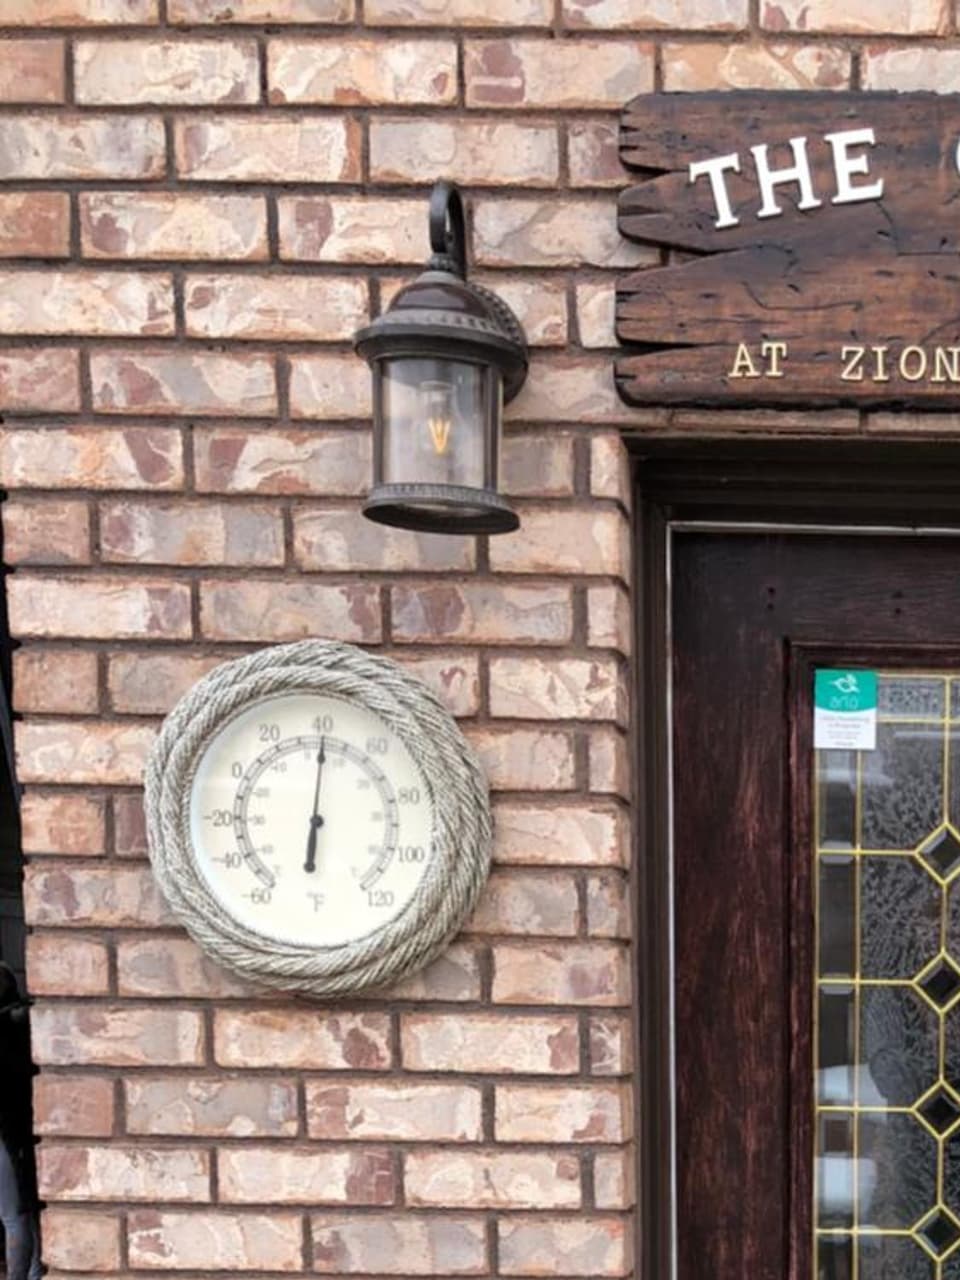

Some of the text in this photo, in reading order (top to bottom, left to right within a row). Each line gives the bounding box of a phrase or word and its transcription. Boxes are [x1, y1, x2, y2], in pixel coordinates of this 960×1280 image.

[687, 127, 886, 230] THE
[727, 341, 788, 378] AT
[312, 715, 333, 731] 40
[259, 725, 280, 741] 20
[365, 738, 388, 754] 60
[231, 761, 243, 778] 0
[398, 788, 421, 804] 80
[398, 846, 425, 863] 100
[367, 890, 393, 906] 120
